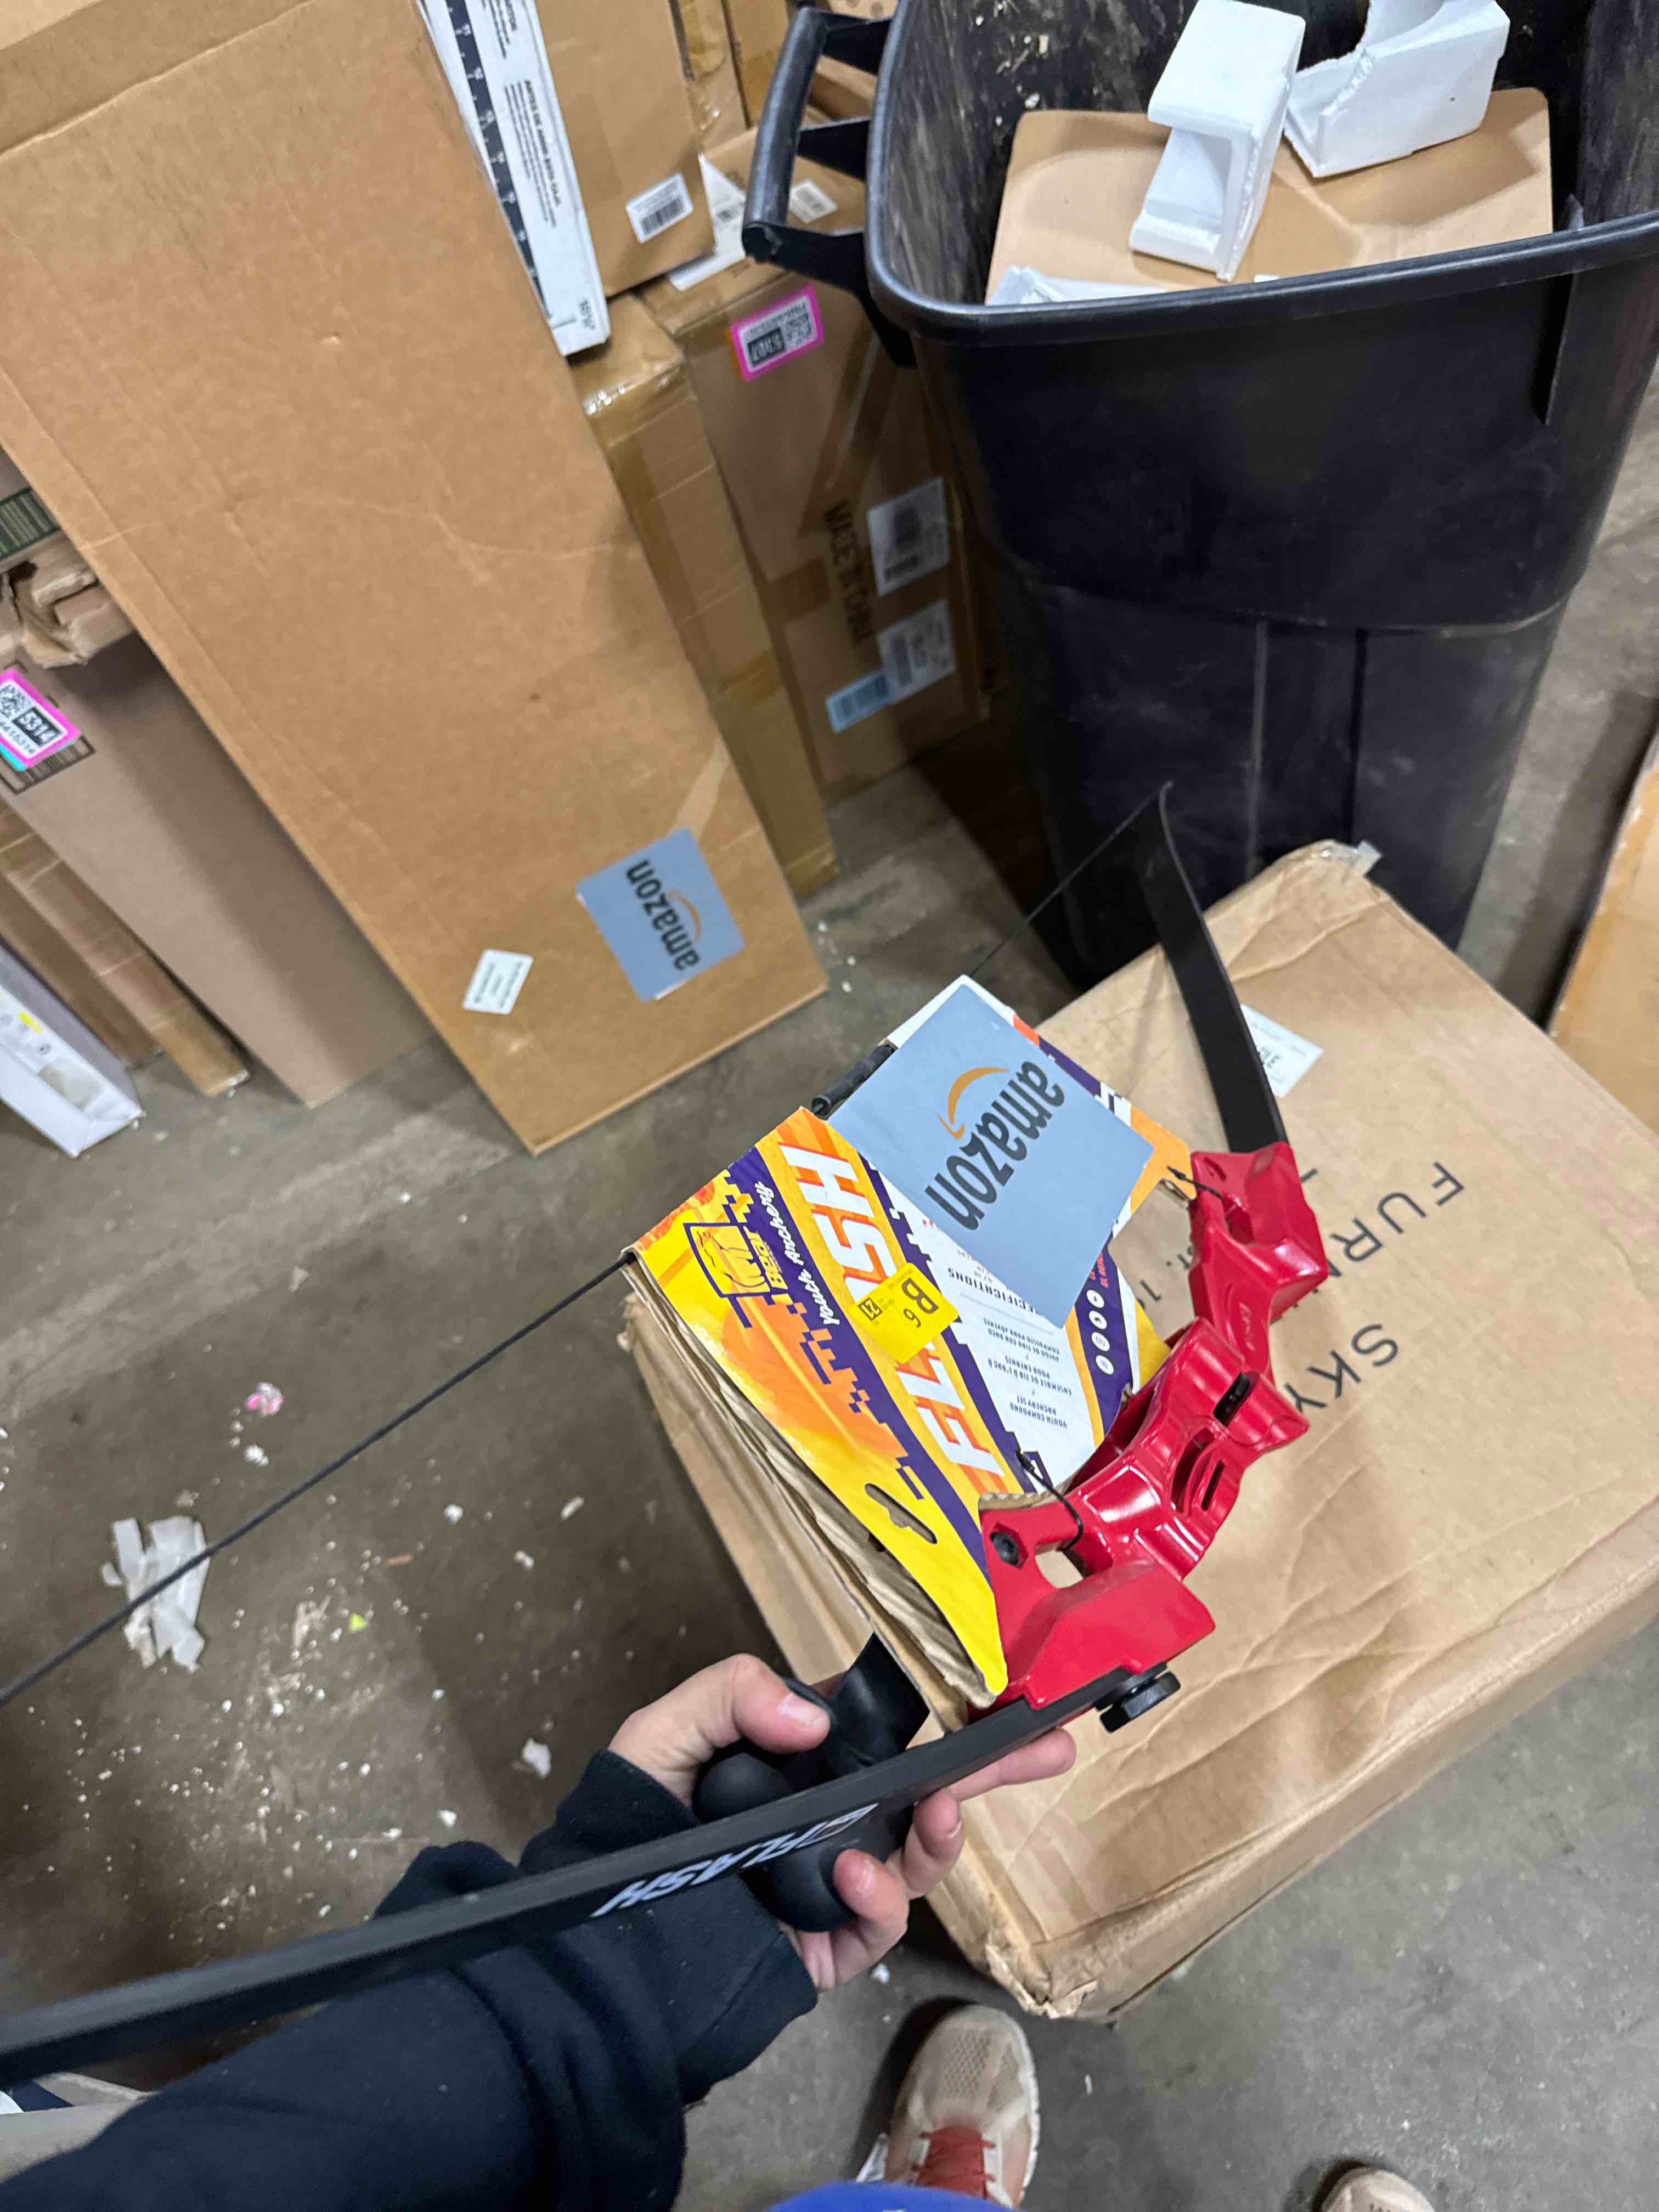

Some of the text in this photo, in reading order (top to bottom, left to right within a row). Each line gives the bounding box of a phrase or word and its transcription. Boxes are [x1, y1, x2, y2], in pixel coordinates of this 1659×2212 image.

[625, 858, 702, 972] amazon
[924, 1060, 1065, 1231] amazon
[743, 1227, 788, 1290] Bear
[754, 1181, 804, 1266] Archery
[779, 1143, 1005, 1477] FLSH
[797, 1268, 840, 1326] Youth
[858, 1299, 881, 1319] 21
[1017, 1395, 1026, 1405] SET
[1285, 1323, 1400, 1413] SKY
[591, 1820, 831, 1918] FLASH
